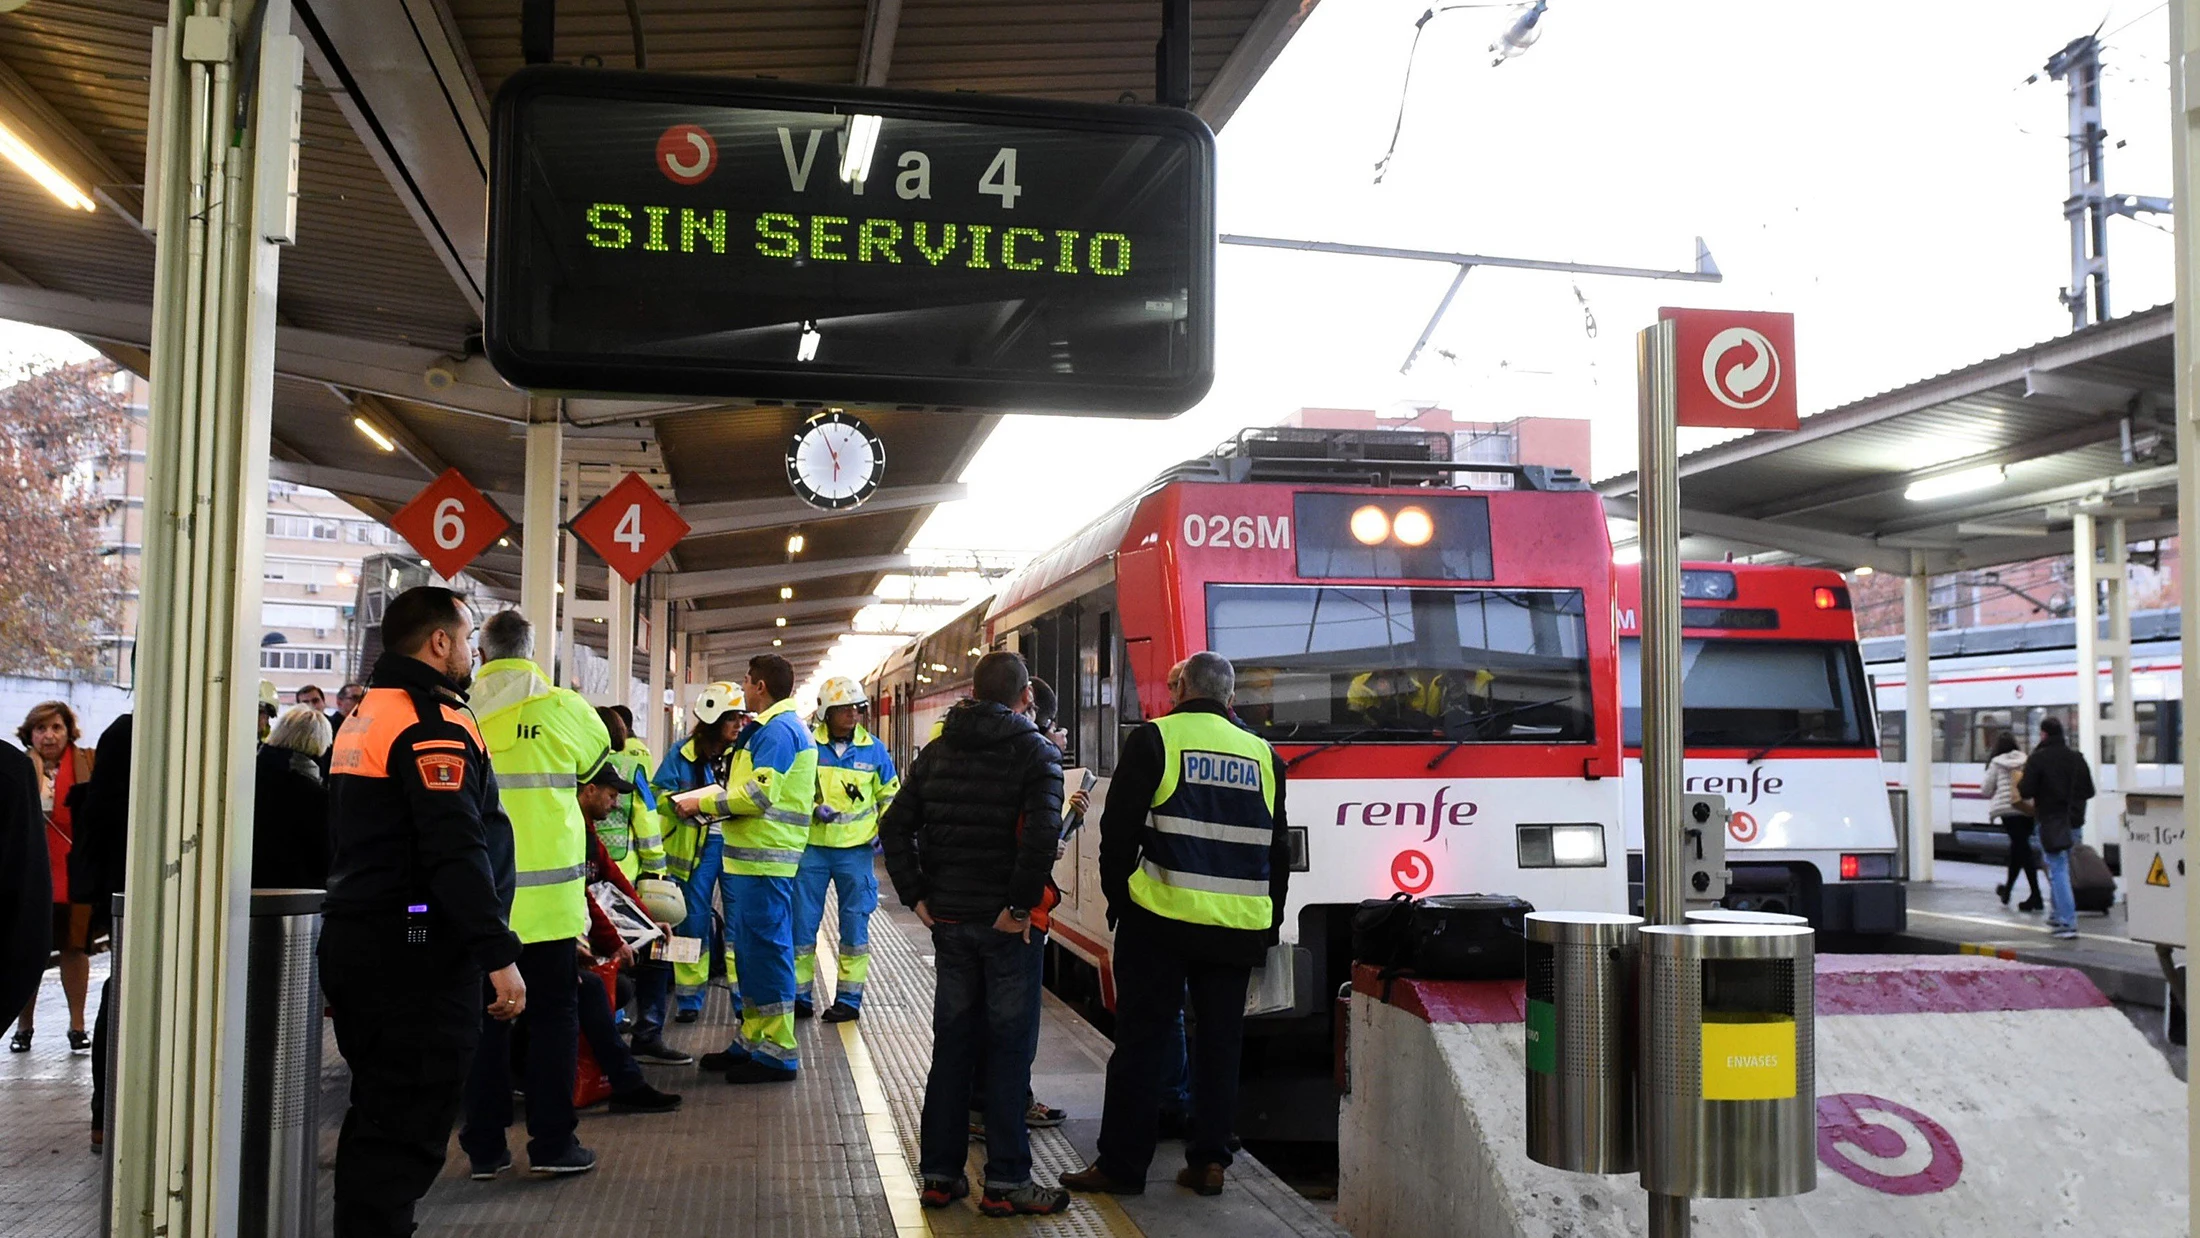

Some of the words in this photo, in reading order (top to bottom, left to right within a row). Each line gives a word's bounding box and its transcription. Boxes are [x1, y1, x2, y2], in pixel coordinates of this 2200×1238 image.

[777, 126, 932, 201] Va
[978, 147, 1022, 209] 4
[587, 203, 726, 254] SIN
[755, 211, 1132, 276] SERVICIO
[433, 497, 465, 550] 6
[613, 503, 645, 553] 4
[1183, 513, 1290, 549] 026M
[1187, 756, 1257, 787] POLICIA
[1686, 766, 1784, 805] renfe
[1336, 785, 1478, 843] renfe
[1727, 1054, 1778, 1069] ENVASES
